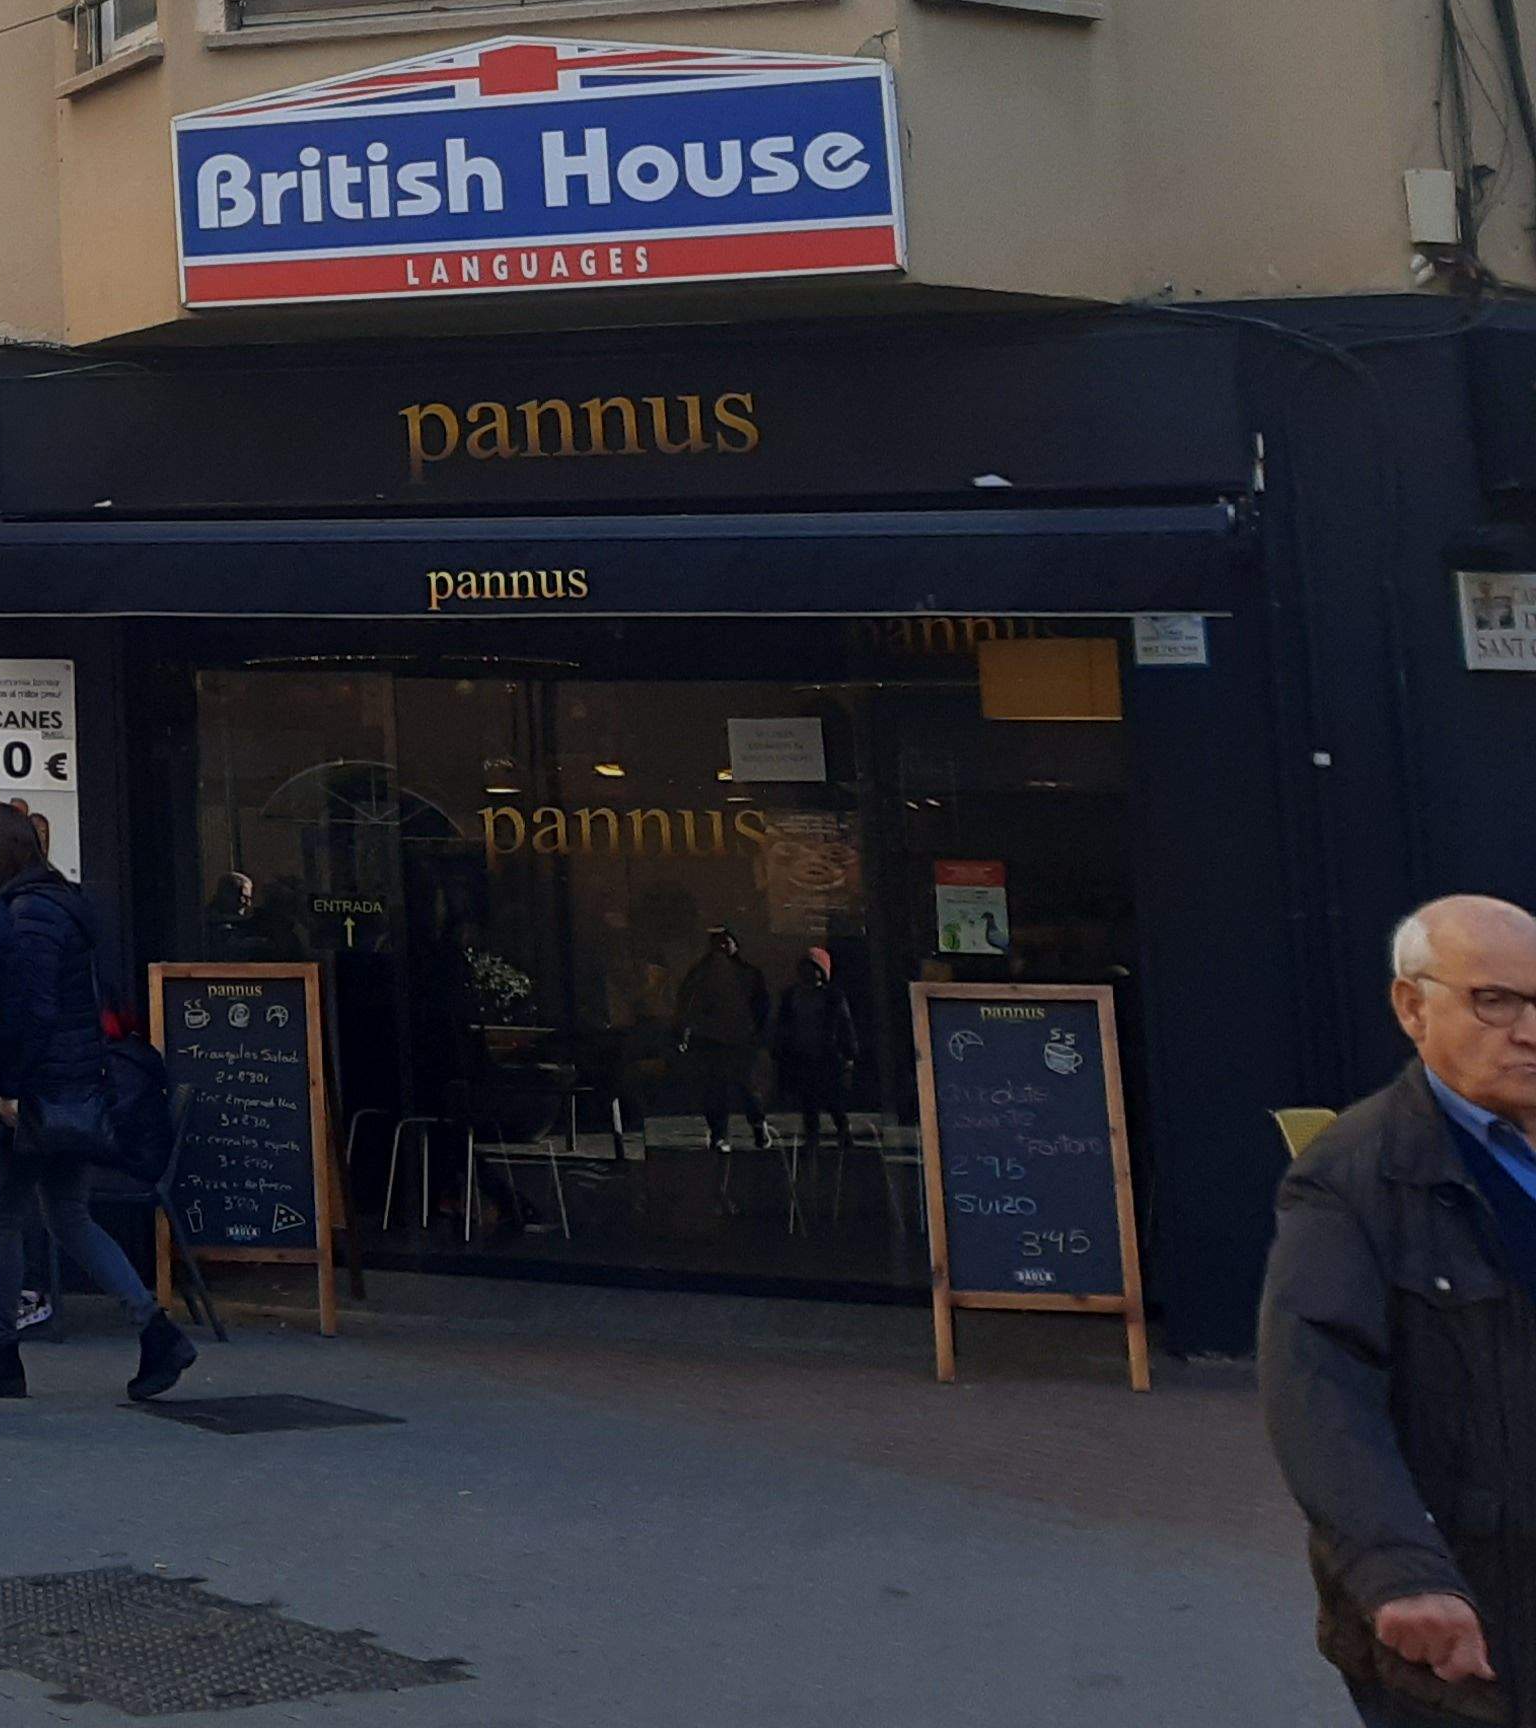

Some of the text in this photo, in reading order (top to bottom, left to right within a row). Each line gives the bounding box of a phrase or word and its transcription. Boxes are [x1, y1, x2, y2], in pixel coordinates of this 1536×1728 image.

[197, 127, 872, 231] British House
[406, 245, 650, 287] LANGUAGES
[397, 387, 762, 482] pannus
[427, 567, 589, 610] pannus
[44, 752, 68, 781] €
[475, 801, 773, 872] pannus
[313, 898, 384, 914] ENTRADA
[206, 982, 263, 999] pannus
[980, 1004, 1047, 1021] pannus
